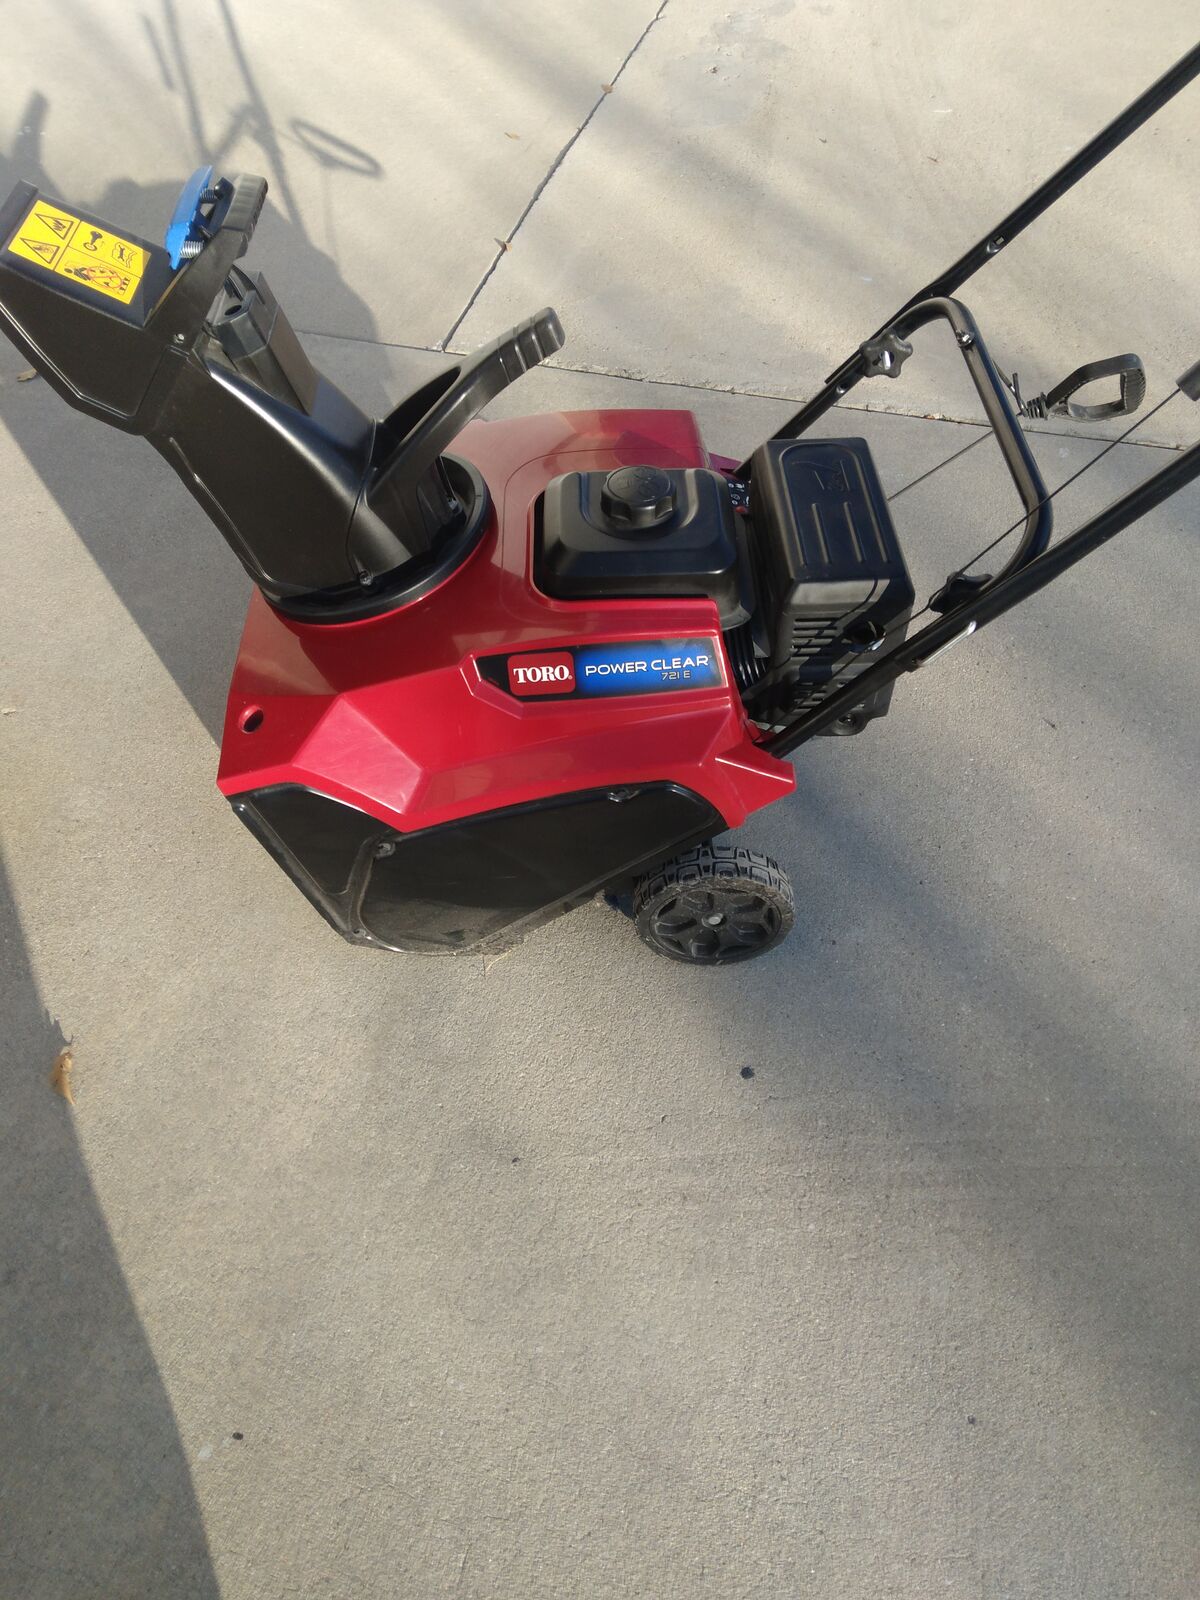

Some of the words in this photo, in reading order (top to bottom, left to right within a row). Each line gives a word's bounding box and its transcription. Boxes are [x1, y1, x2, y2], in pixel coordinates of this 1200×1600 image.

[513, 665, 570, 684] TORO
[585, 661, 647, 676] POWER
[651, 655, 709, 670] CLEAR
[683, 670, 691, 678] E
